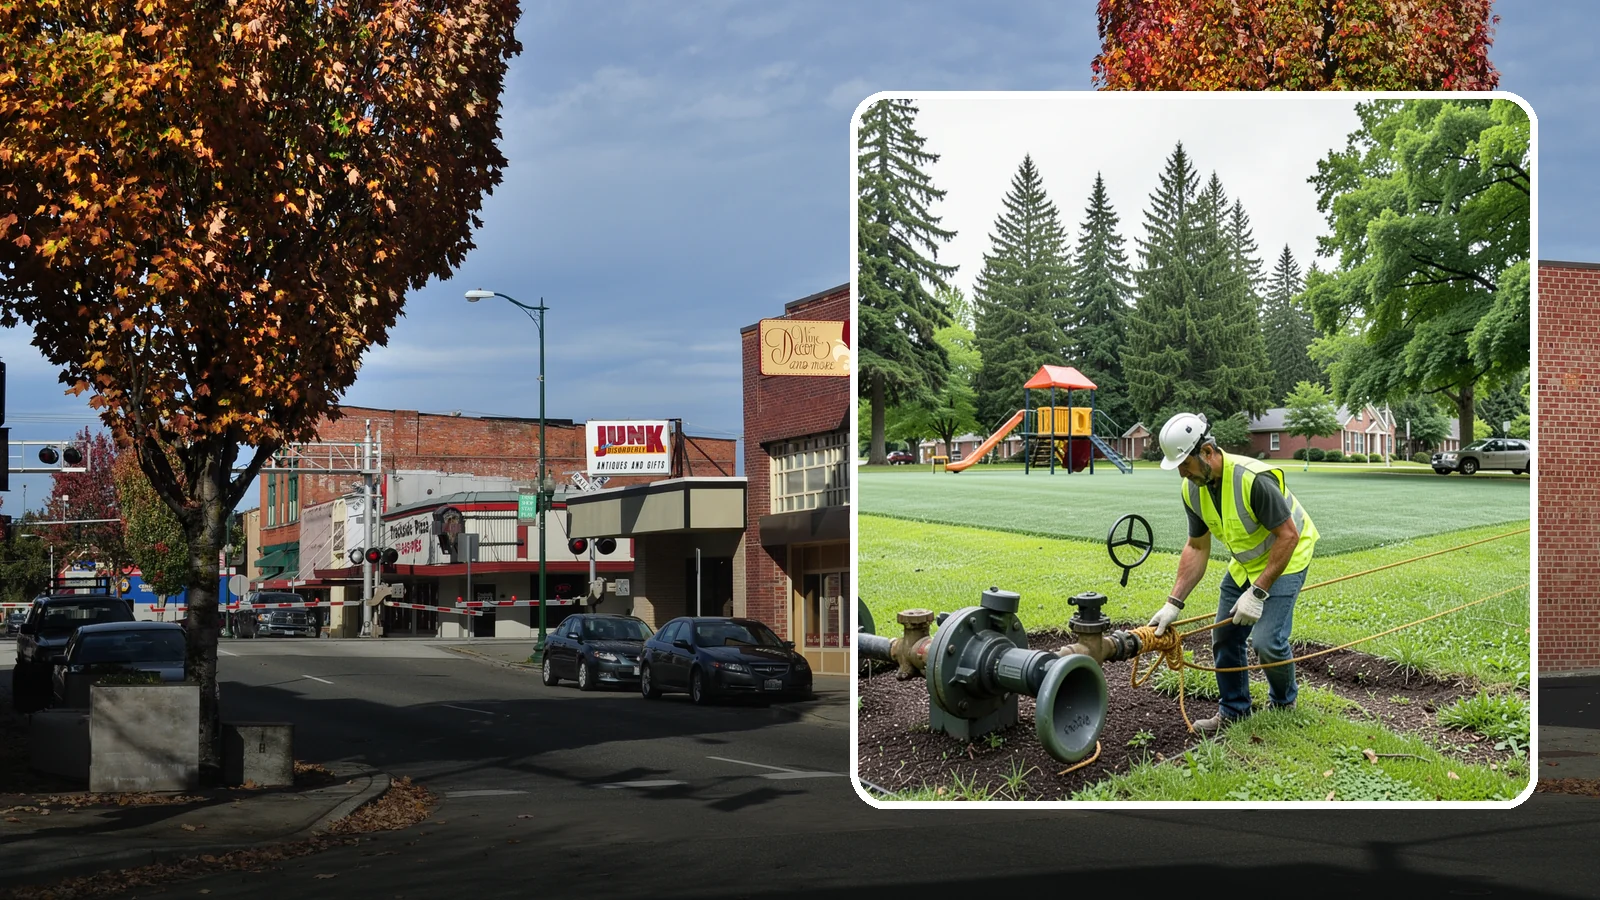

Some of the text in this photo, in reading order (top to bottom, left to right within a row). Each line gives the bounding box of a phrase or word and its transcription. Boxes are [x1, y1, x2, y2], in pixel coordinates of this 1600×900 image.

[596, 425, 665, 457] JUNK
[607, 446, 646, 454] DISORDERLY
[597, 460, 666, 470] ANTIQUES AND GIFTS
[415, 520, 429, 535] Pizza
